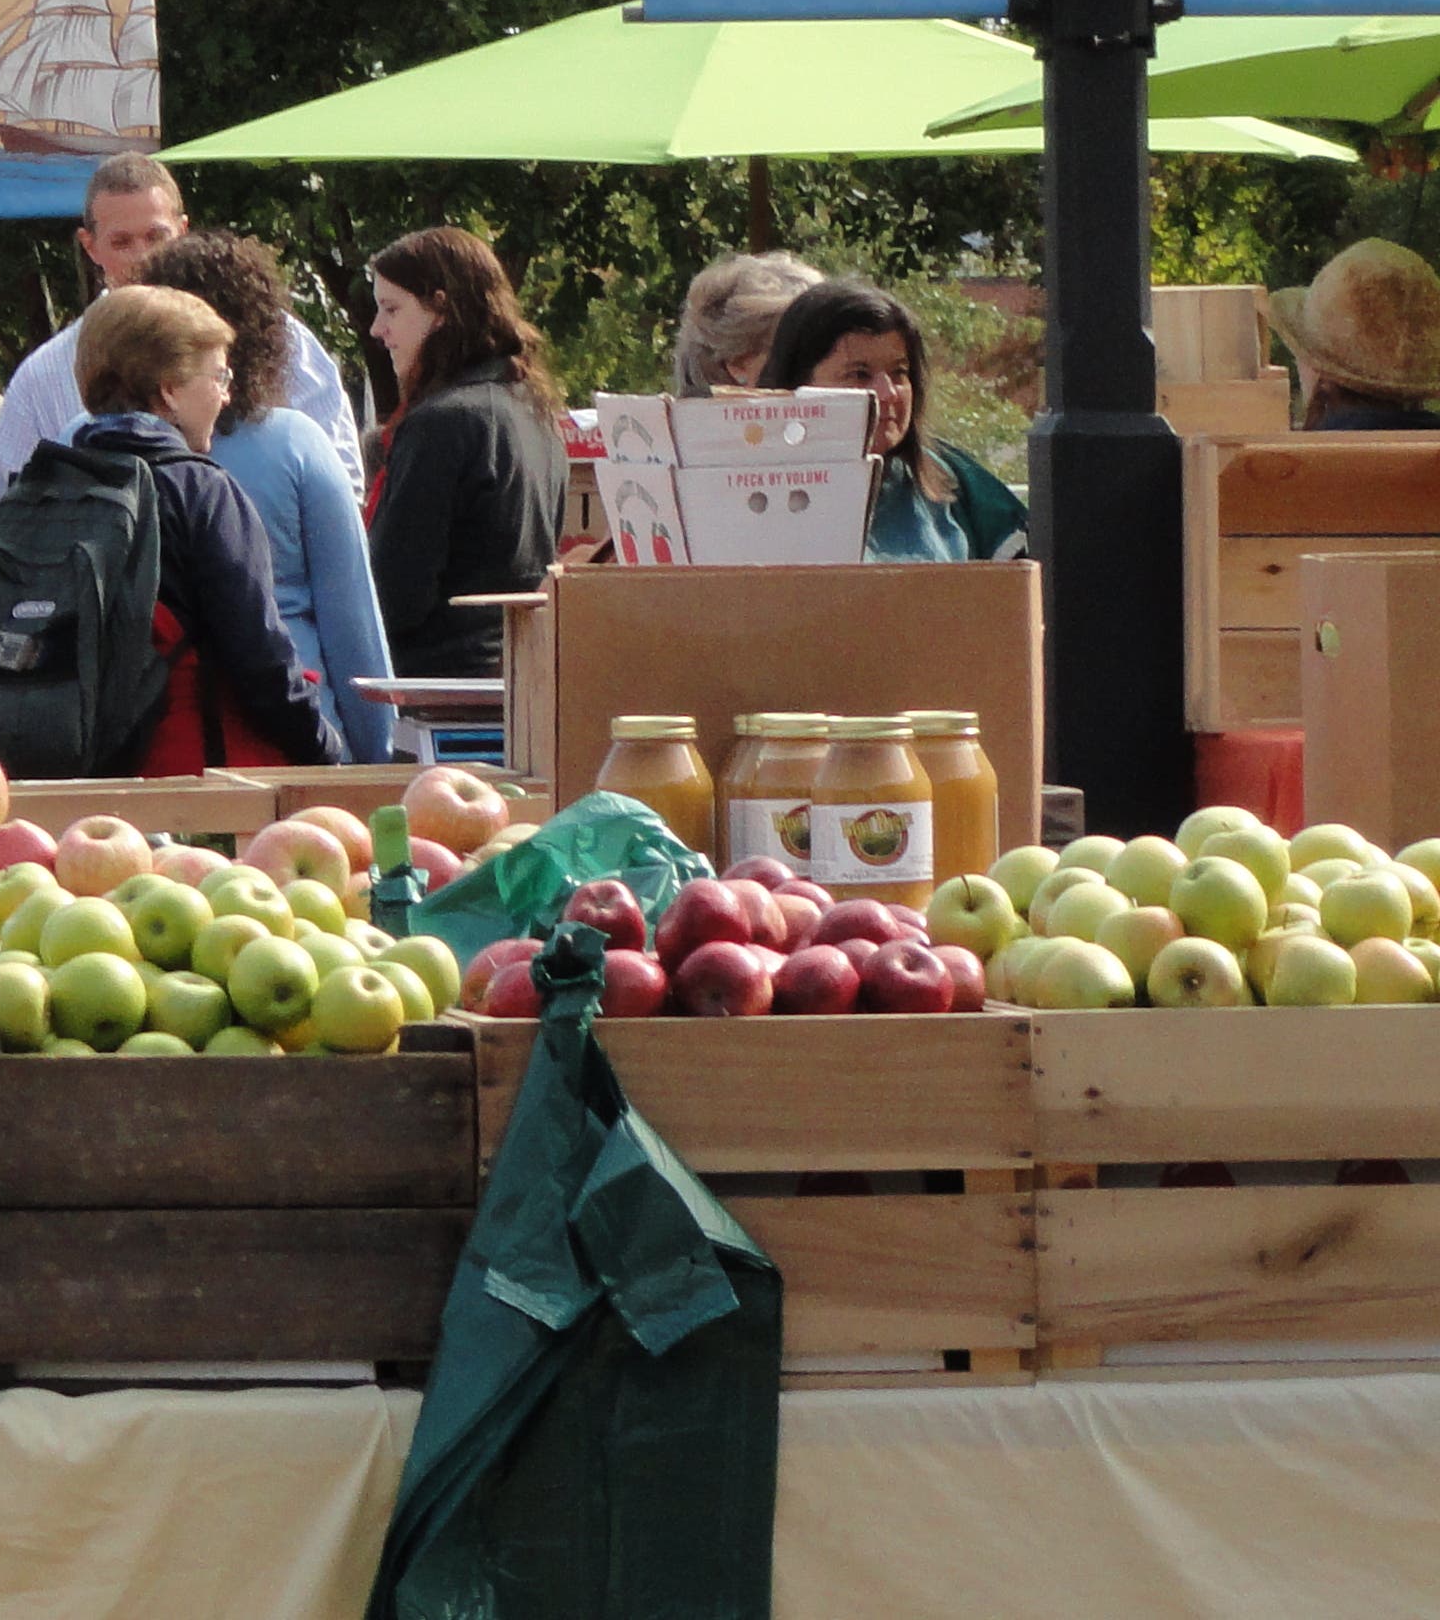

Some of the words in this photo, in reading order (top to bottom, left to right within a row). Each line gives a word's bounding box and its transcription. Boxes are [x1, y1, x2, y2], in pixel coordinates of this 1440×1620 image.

[723, 406, 729, 420] 1
[733, 406, 761, 420] PECK
[765, 406, 779, 420] BY
[783, 404, 827, 419] VOLUME
[727, 474, 732, 488] 1
[736, 473, 764, 488] PECK
[768, 472, 782, 486] BY
[786, 470, 829, 485] VOLUME
